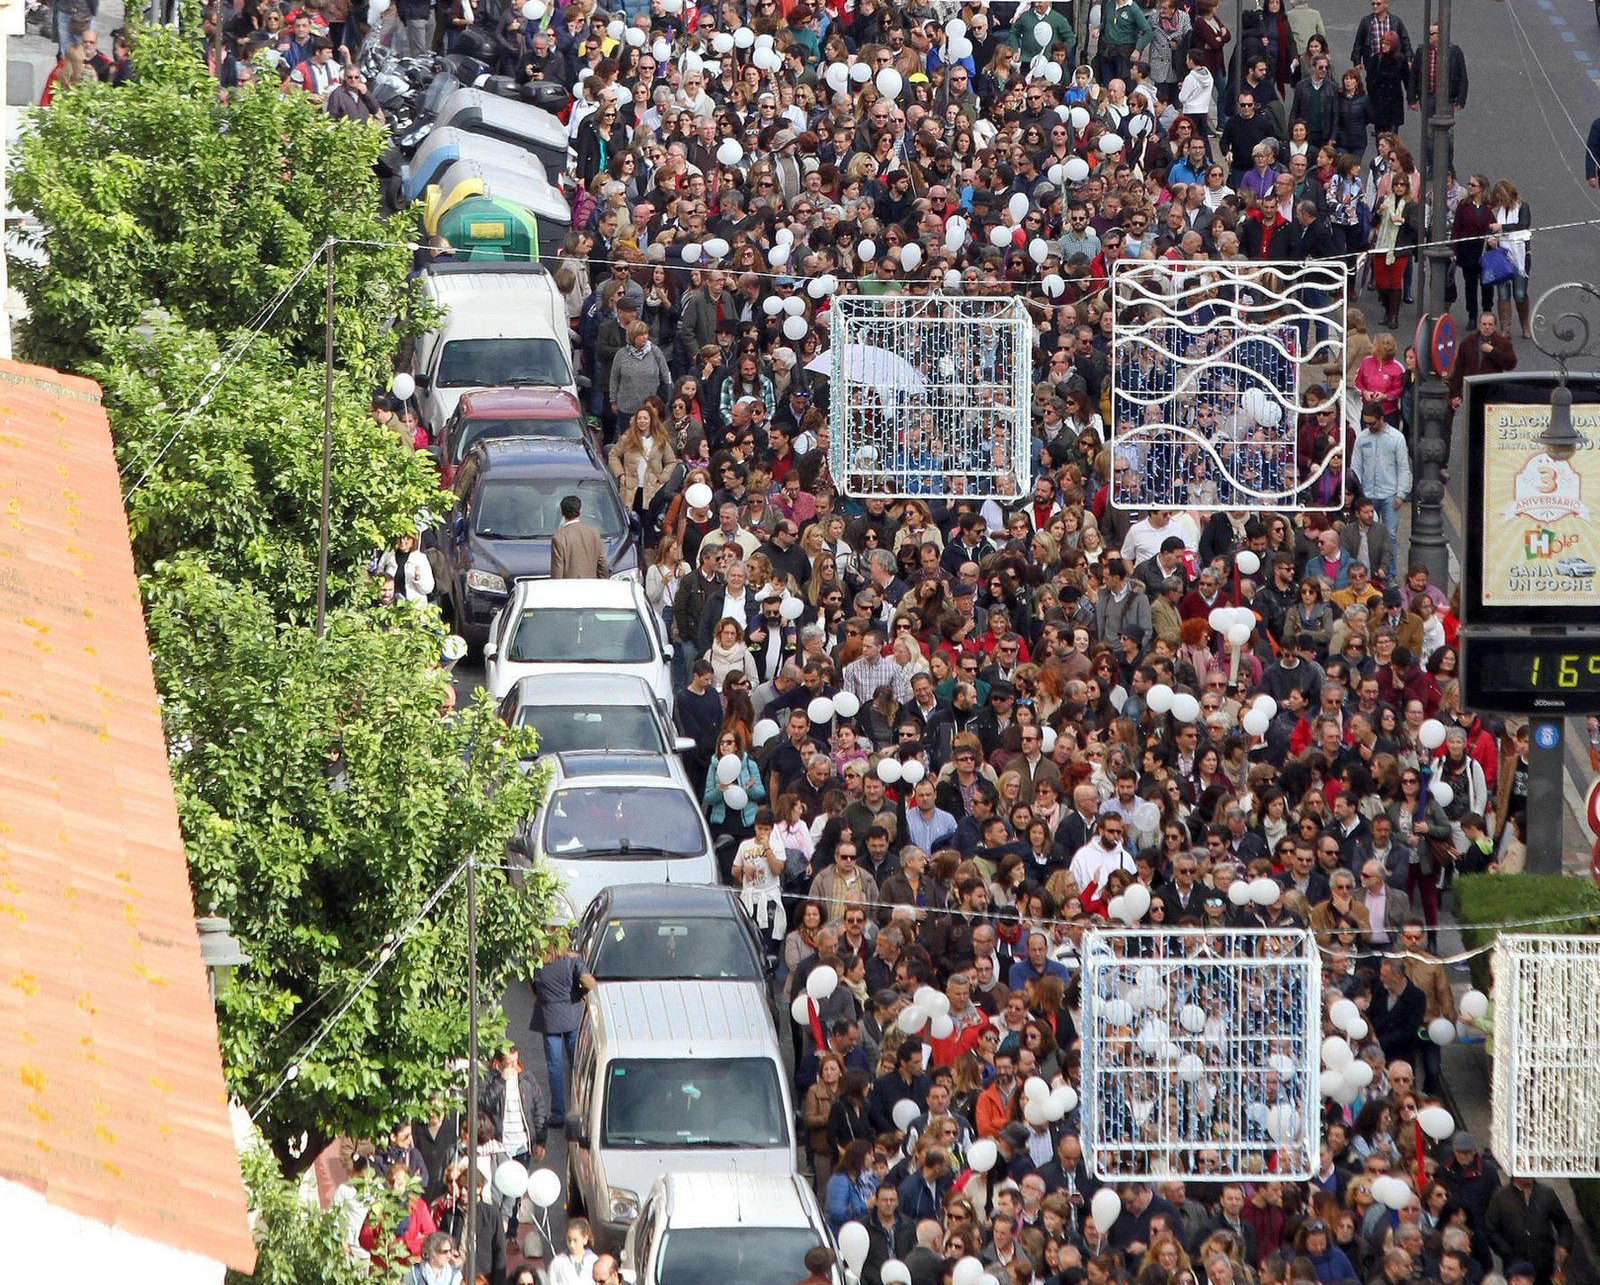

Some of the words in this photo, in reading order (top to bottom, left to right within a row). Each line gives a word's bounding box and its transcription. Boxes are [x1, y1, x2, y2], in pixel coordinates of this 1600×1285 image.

[1499, 416, 1549, 428] BLACK
[1499, 428, 1518, 441] 25
[1516, 496, 1580, 509] ANIVERSARIO
[1509, 565, 1553, 577] GANA
[1508, 579, 1531, 591] UN
[1534, 579, 1593, 592] COCHE
